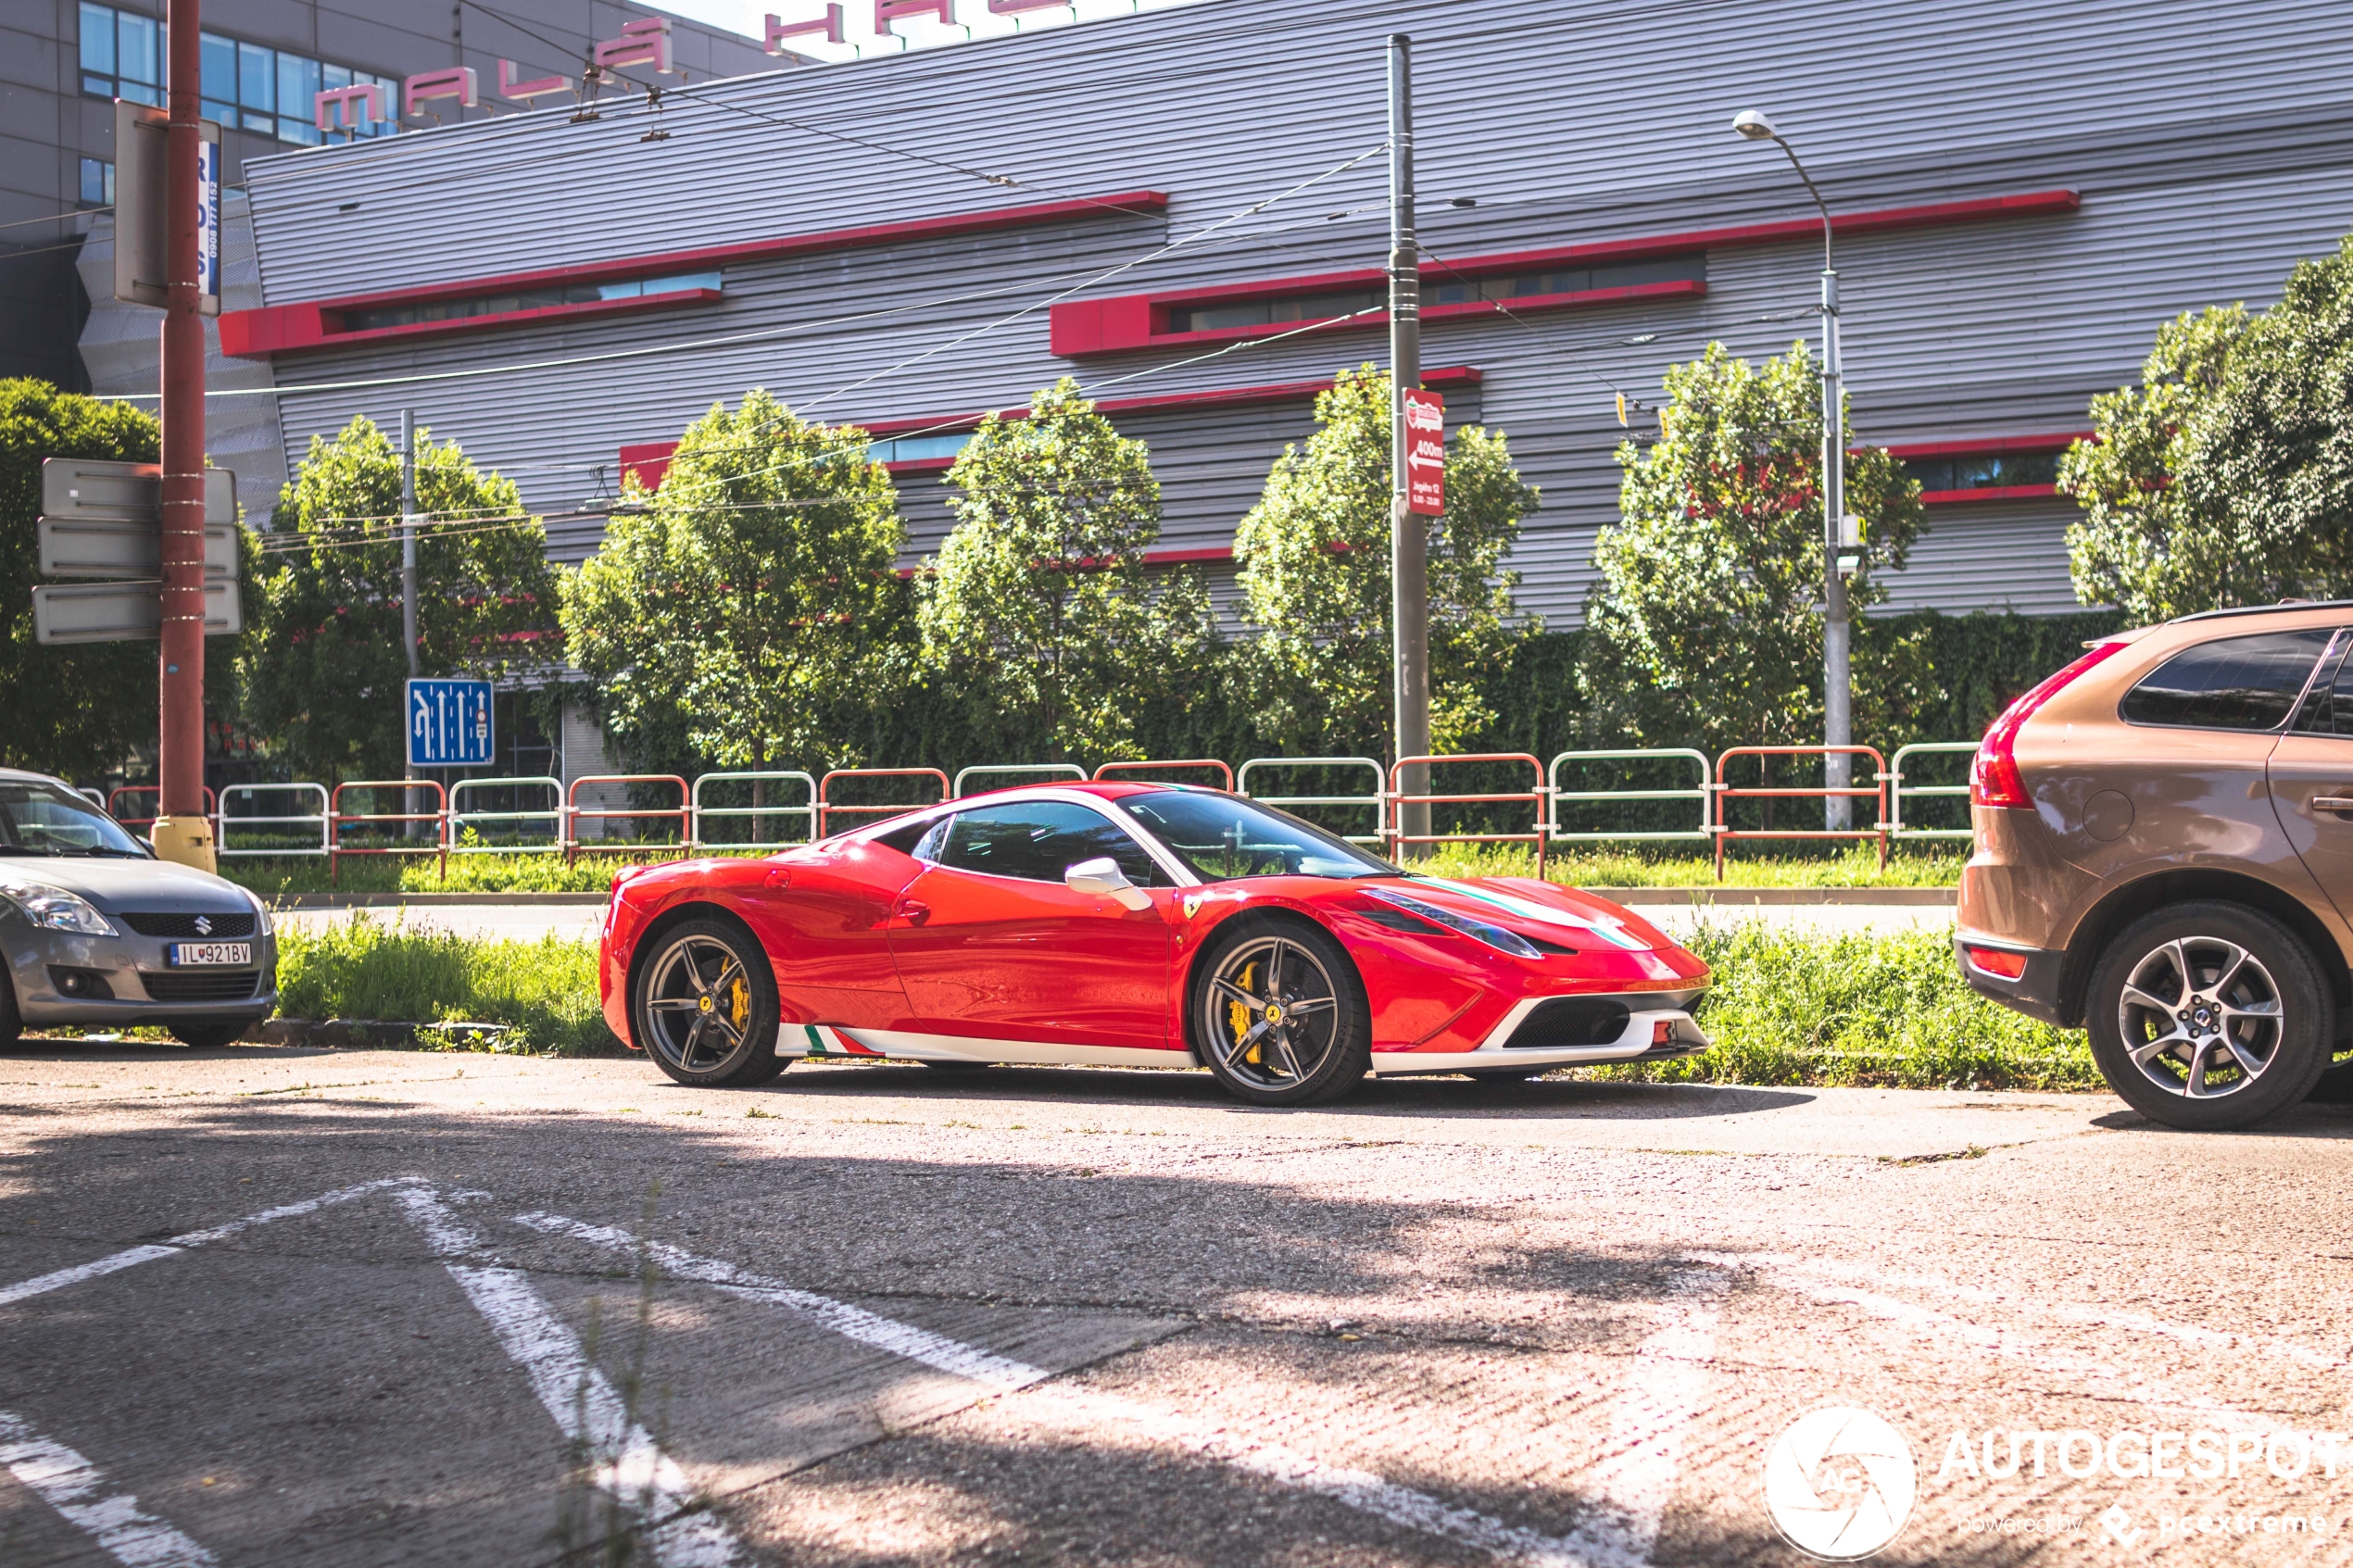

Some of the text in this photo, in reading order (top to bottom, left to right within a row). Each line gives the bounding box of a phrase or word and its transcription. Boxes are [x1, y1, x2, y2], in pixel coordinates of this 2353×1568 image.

[209, 182, 218, 202] 152
[209, 206, 218, 227] 777
[1417, 440, 1443, 458] 400m
[206, 945, 248, 963] 921BV
